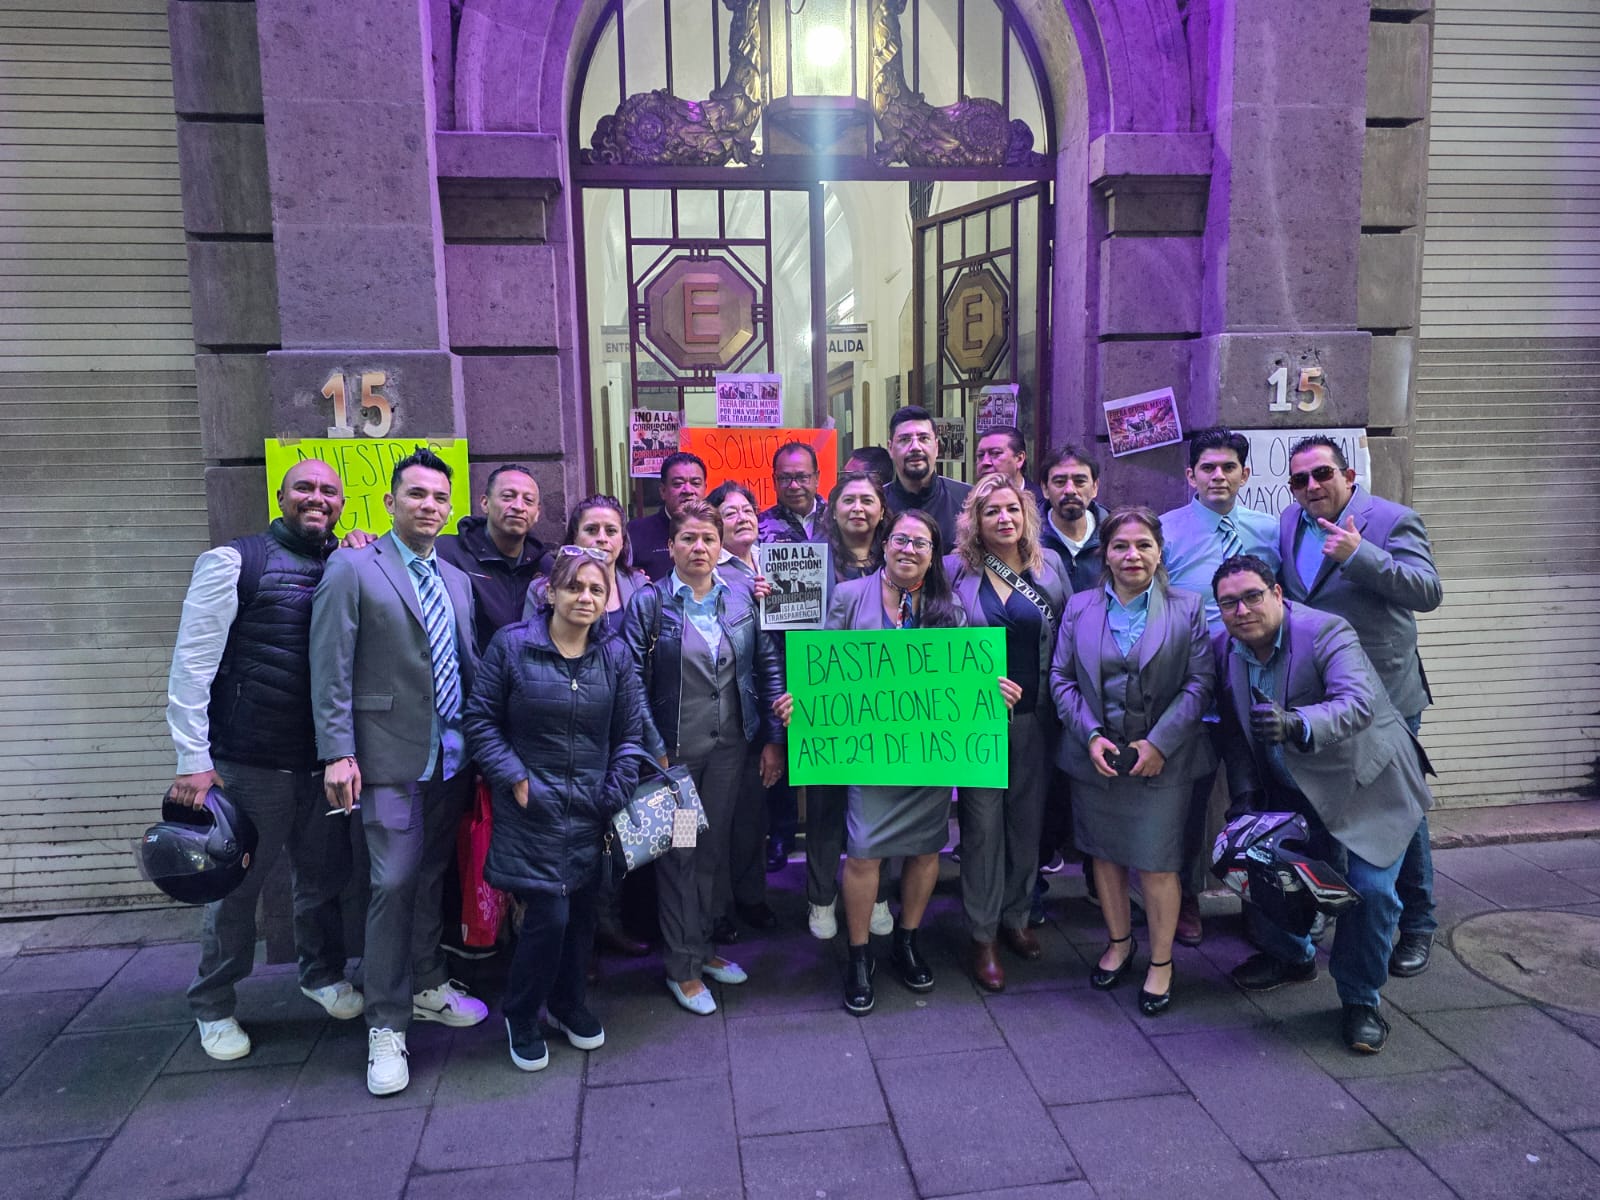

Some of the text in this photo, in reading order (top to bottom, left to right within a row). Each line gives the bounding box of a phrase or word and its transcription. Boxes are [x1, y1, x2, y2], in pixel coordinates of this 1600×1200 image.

[683, 282, 720, 344] E
[963, 293, 983, 351] E
[606, 342, 651, 353] ENTRD
[828, 339, 864, 353] ALIDA
[321, 372, 392, 438] 15
[1267, 366, 1325, 412] 15
[654, 412, 661, 422] A
[662, 412, 673, 422] LA
[704, 431, 812, 471] SOLUC
[1237, 484, 1297, 516] MAYO
[765, 558, 822, 573] CORRUPCIÓN!
[768, 546, 814, 561] ¡NO A LA
[806, 639, 995, 687] BASTA DE LAS
[798, 687, 1001, 728] VIOLACIONES AL
[884, 732, 912, 765] DE
[920, 729, 958, 764] LAS
[965, 732, 1003, 765] CGT
